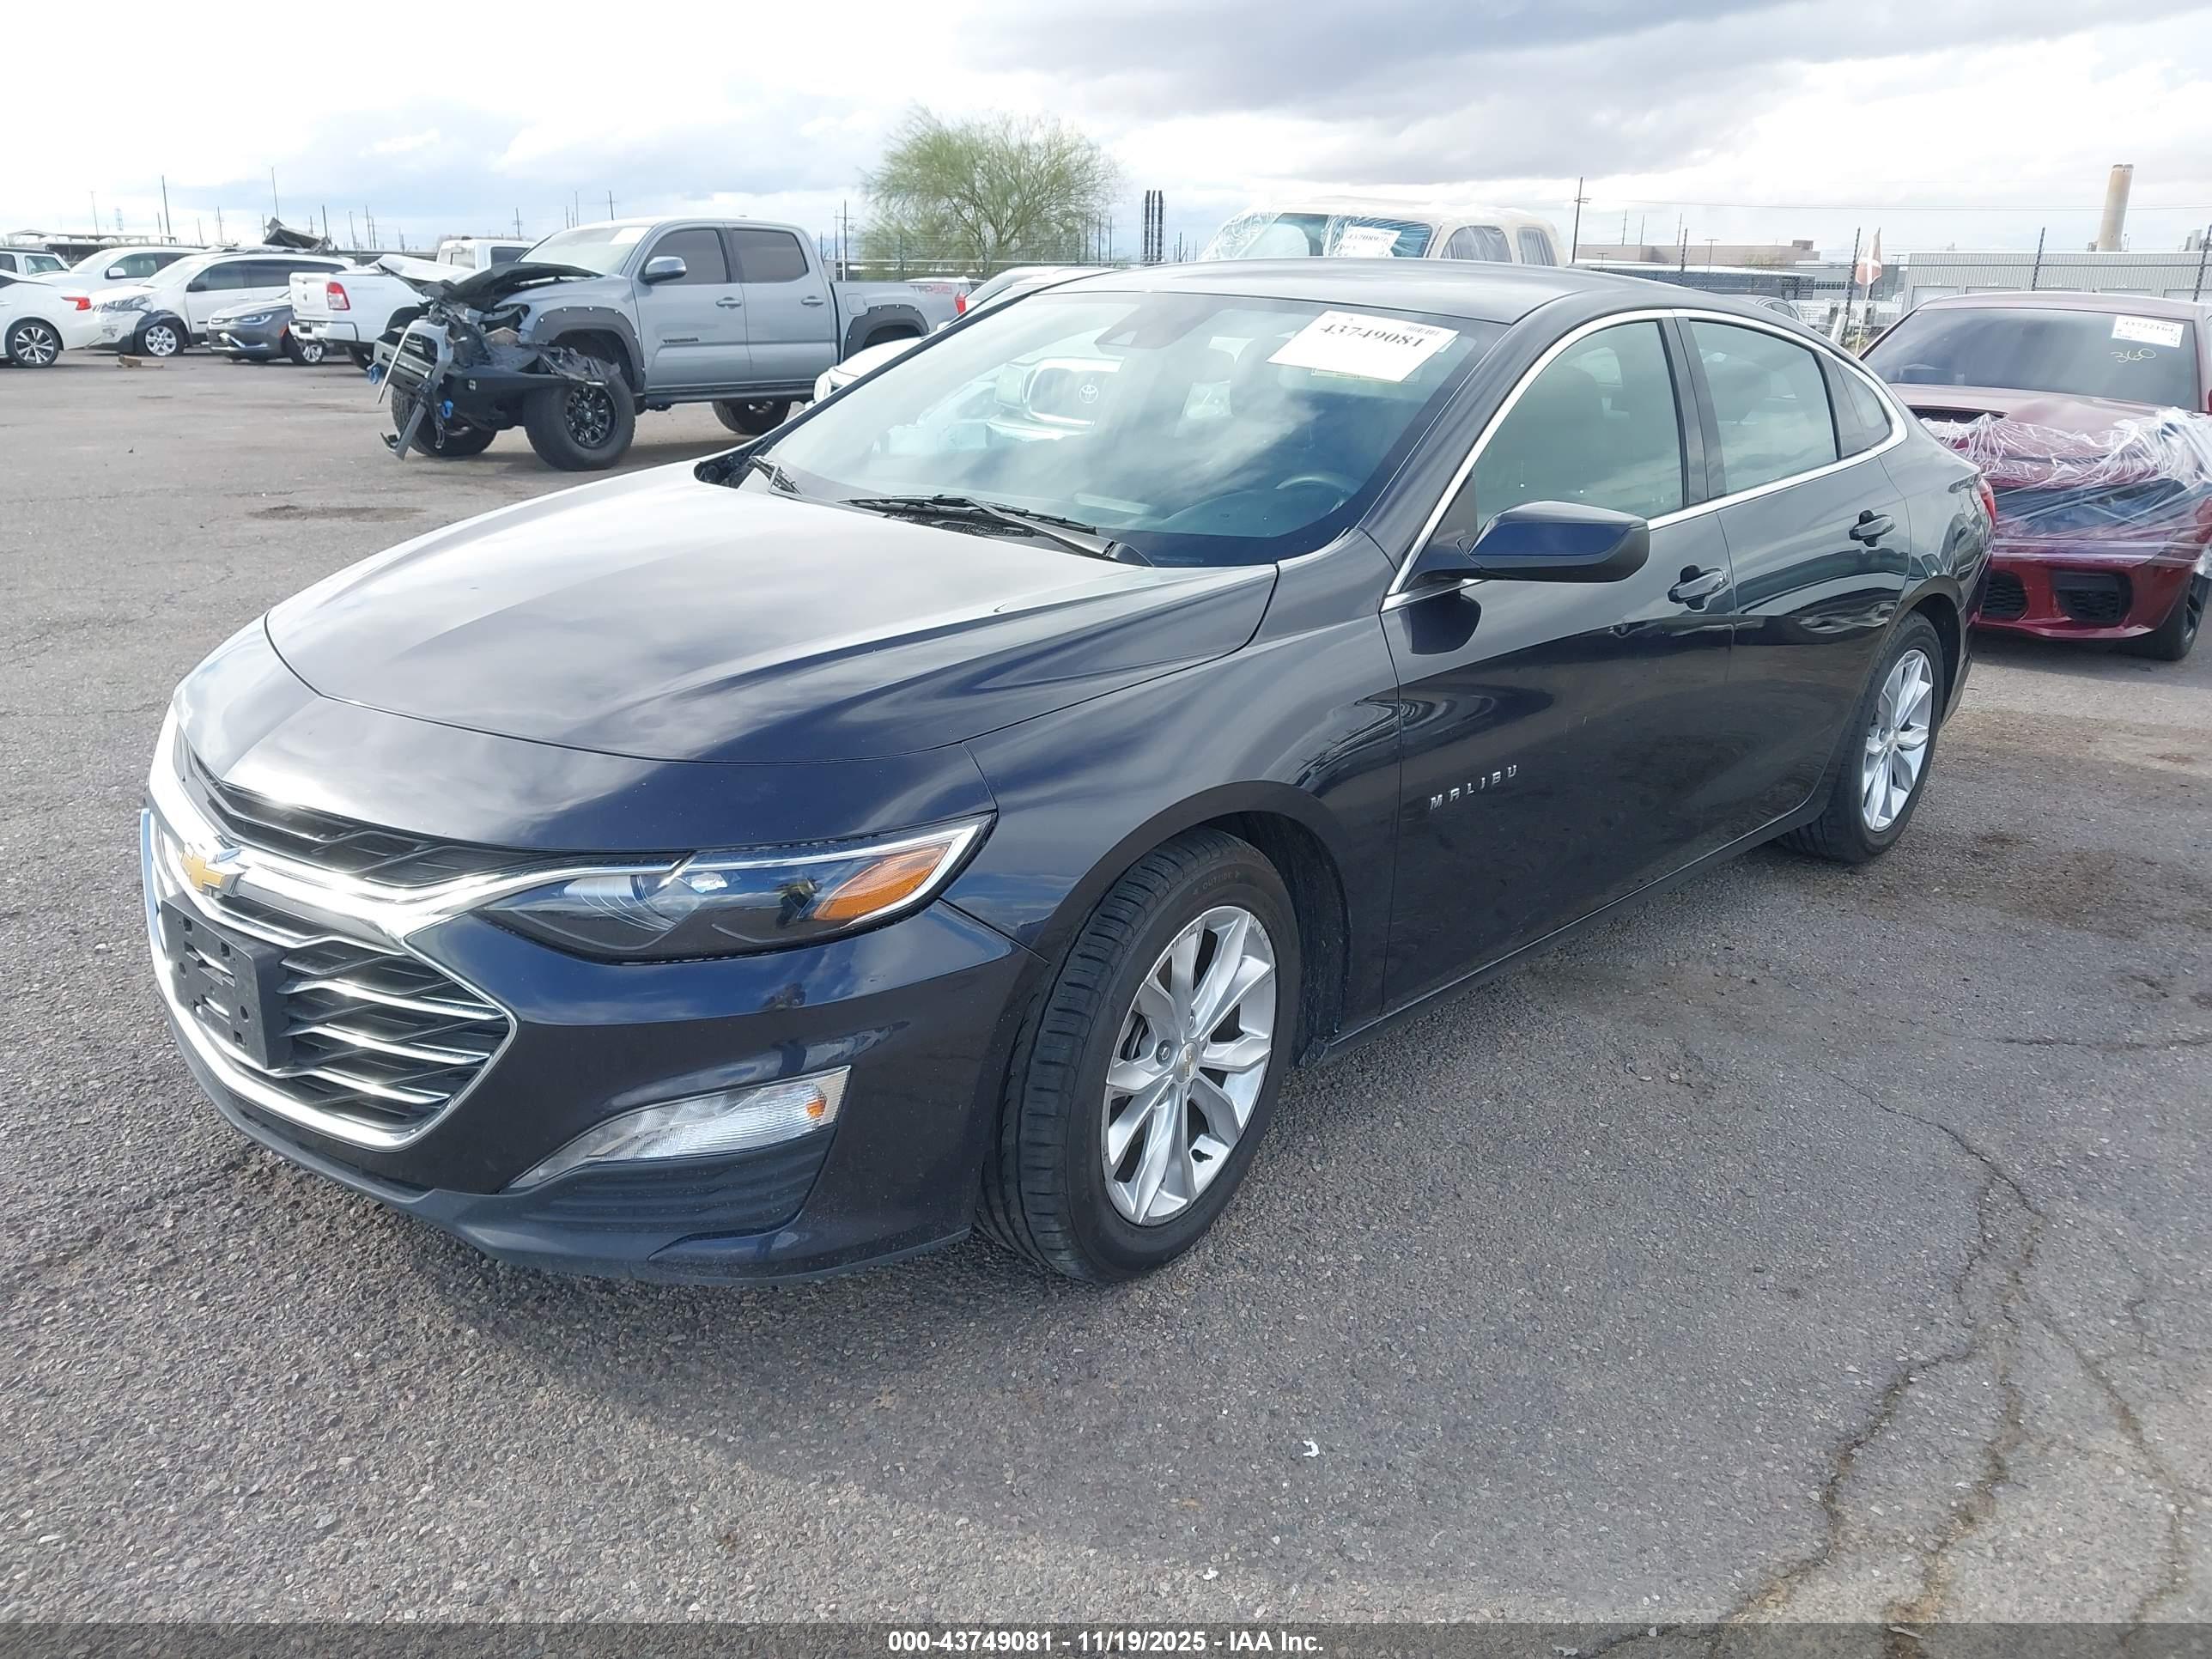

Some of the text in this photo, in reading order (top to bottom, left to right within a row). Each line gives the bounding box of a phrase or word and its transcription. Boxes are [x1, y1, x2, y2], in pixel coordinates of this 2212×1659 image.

[1320, 324, 1425, 347] 43749081
[2109, 348, 2157, 363] 360
[1430, 764, 1518, 811] MALIBU
